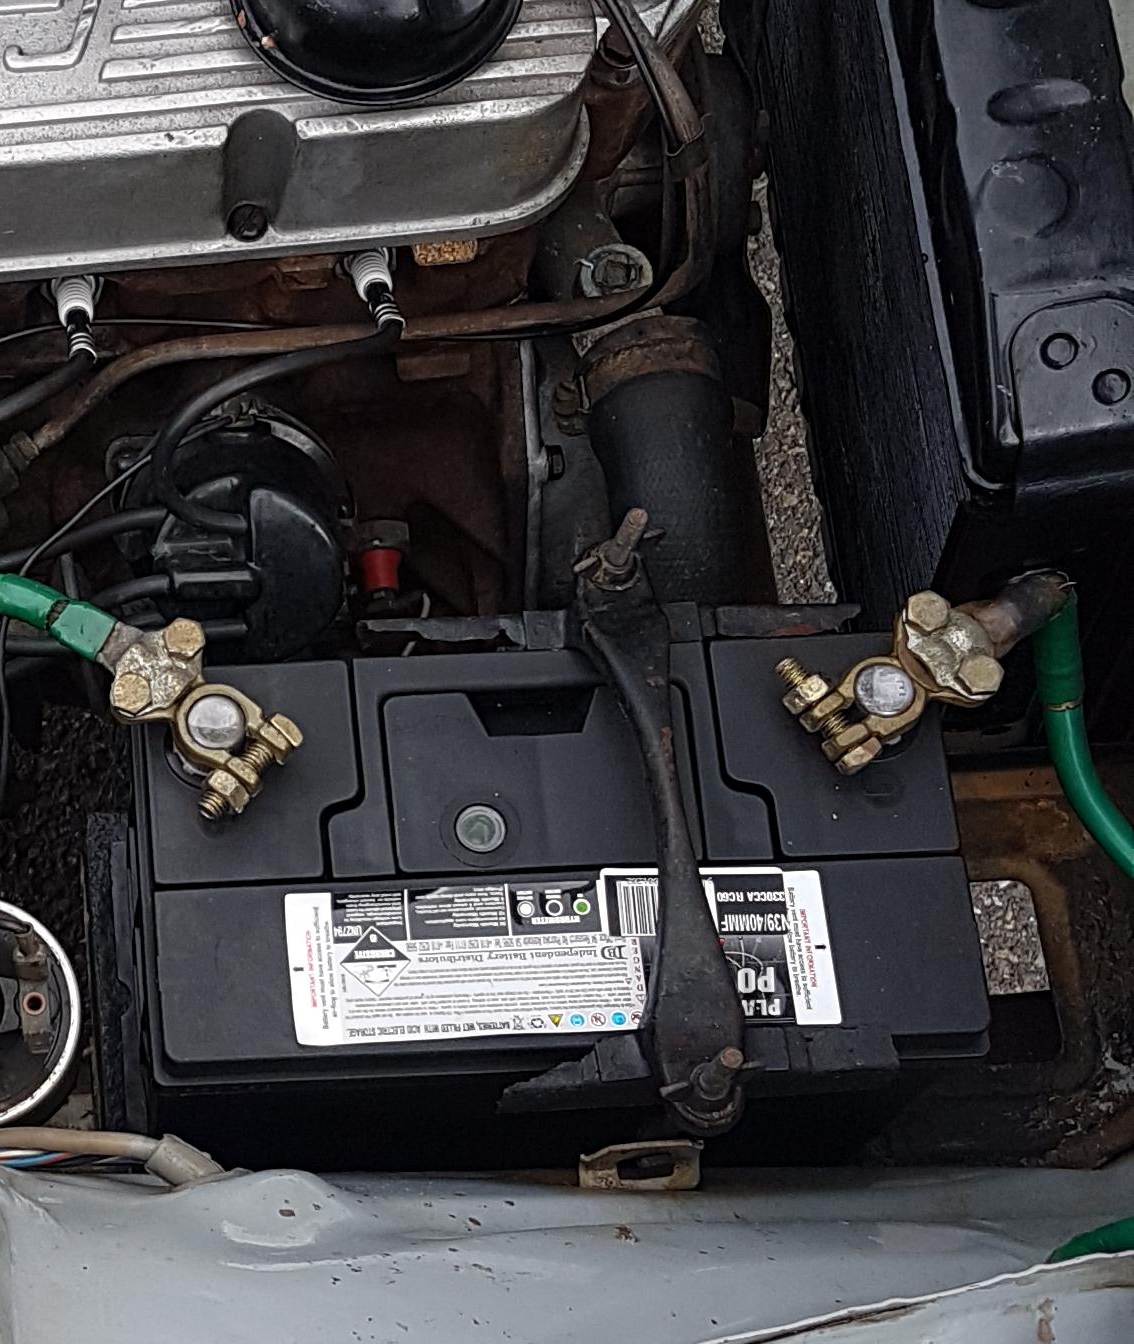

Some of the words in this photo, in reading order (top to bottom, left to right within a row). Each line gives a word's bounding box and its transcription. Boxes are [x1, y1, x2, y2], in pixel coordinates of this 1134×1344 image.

[716, 891, 743, 902] RC60
[746, 890, 784, 901] 330CCA
[417, 953, 483, 964] Distributors
[486, 950, 526, 961] Battery
[529, 946, 596, 959] Independent
[630, 937, 643, 991] DANGER
[736, 966, 775, 993] PO
[741, 997, 780, 1016] PLA
